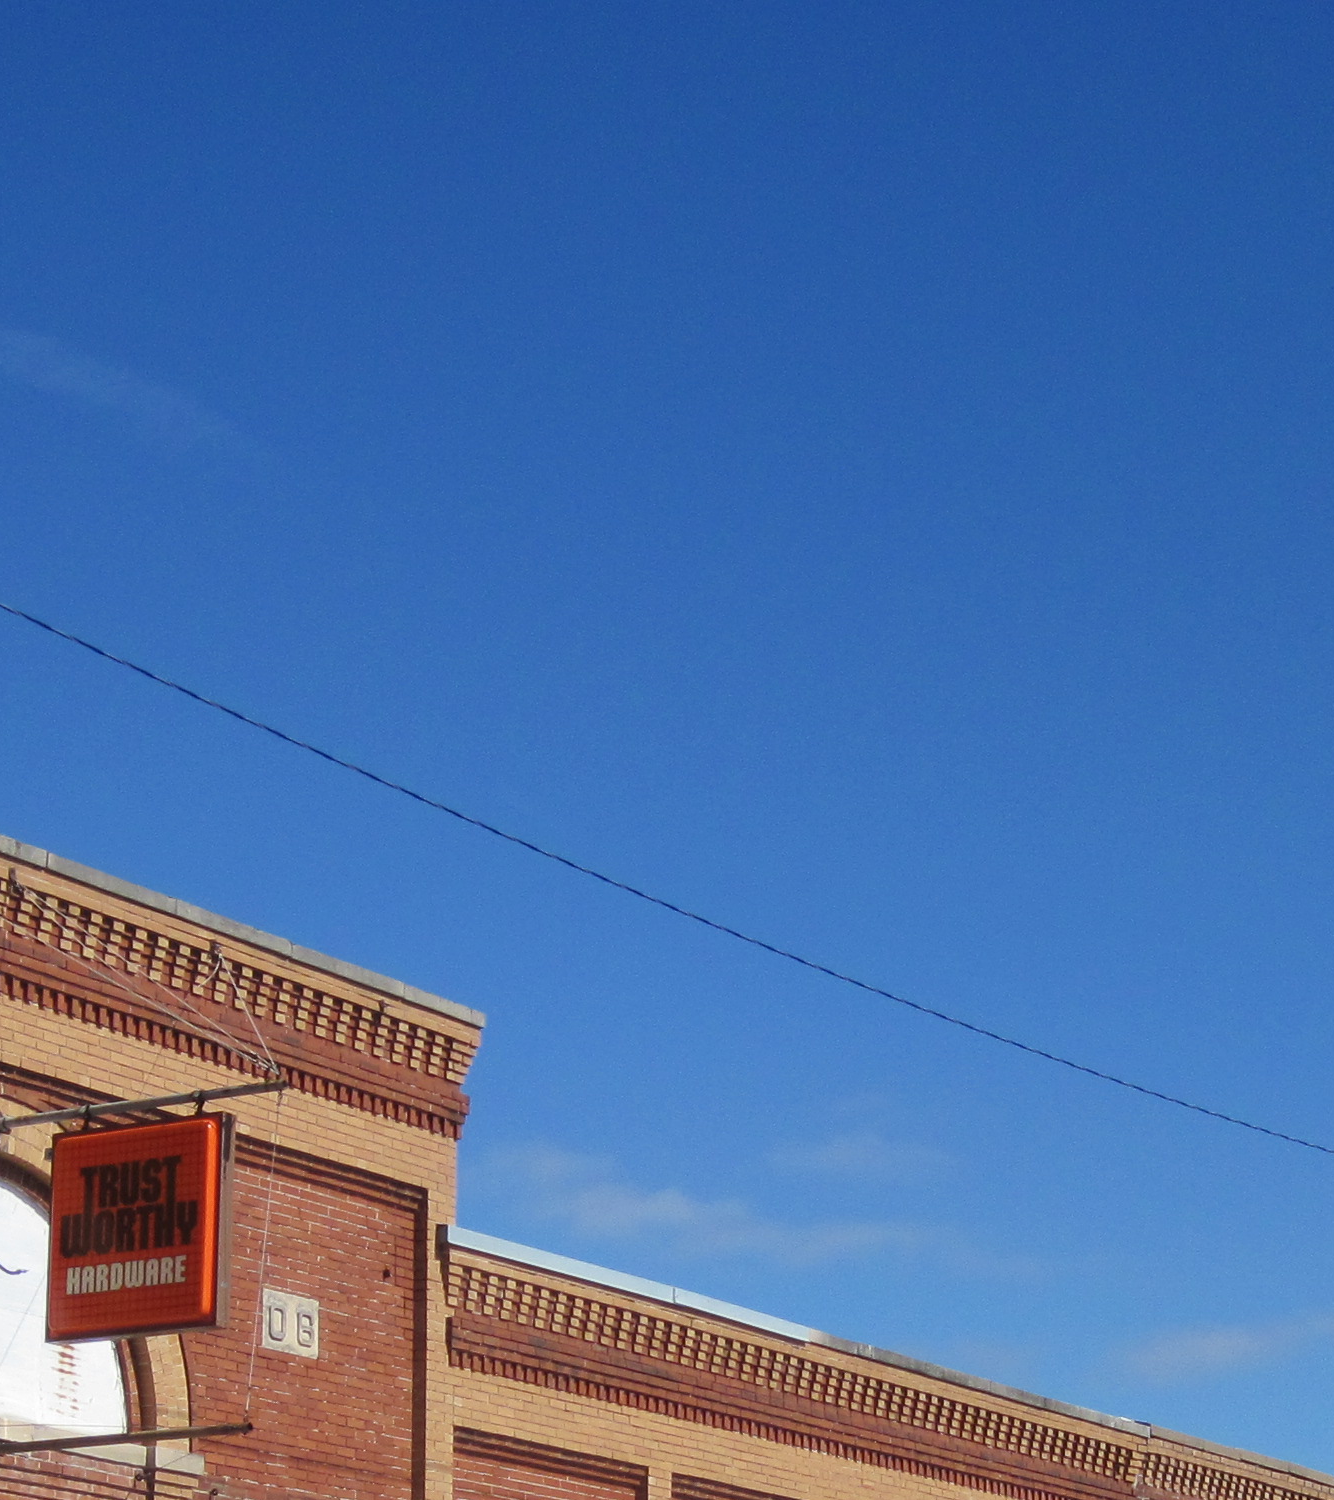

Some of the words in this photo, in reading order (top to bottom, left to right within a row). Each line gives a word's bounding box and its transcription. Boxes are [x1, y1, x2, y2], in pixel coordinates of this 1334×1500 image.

[80, 1155, 182, 1209] TRUST
[60, 1200, 199, 1258] WORTHY
[66, 1255, 187, 1295] HARDWARE
